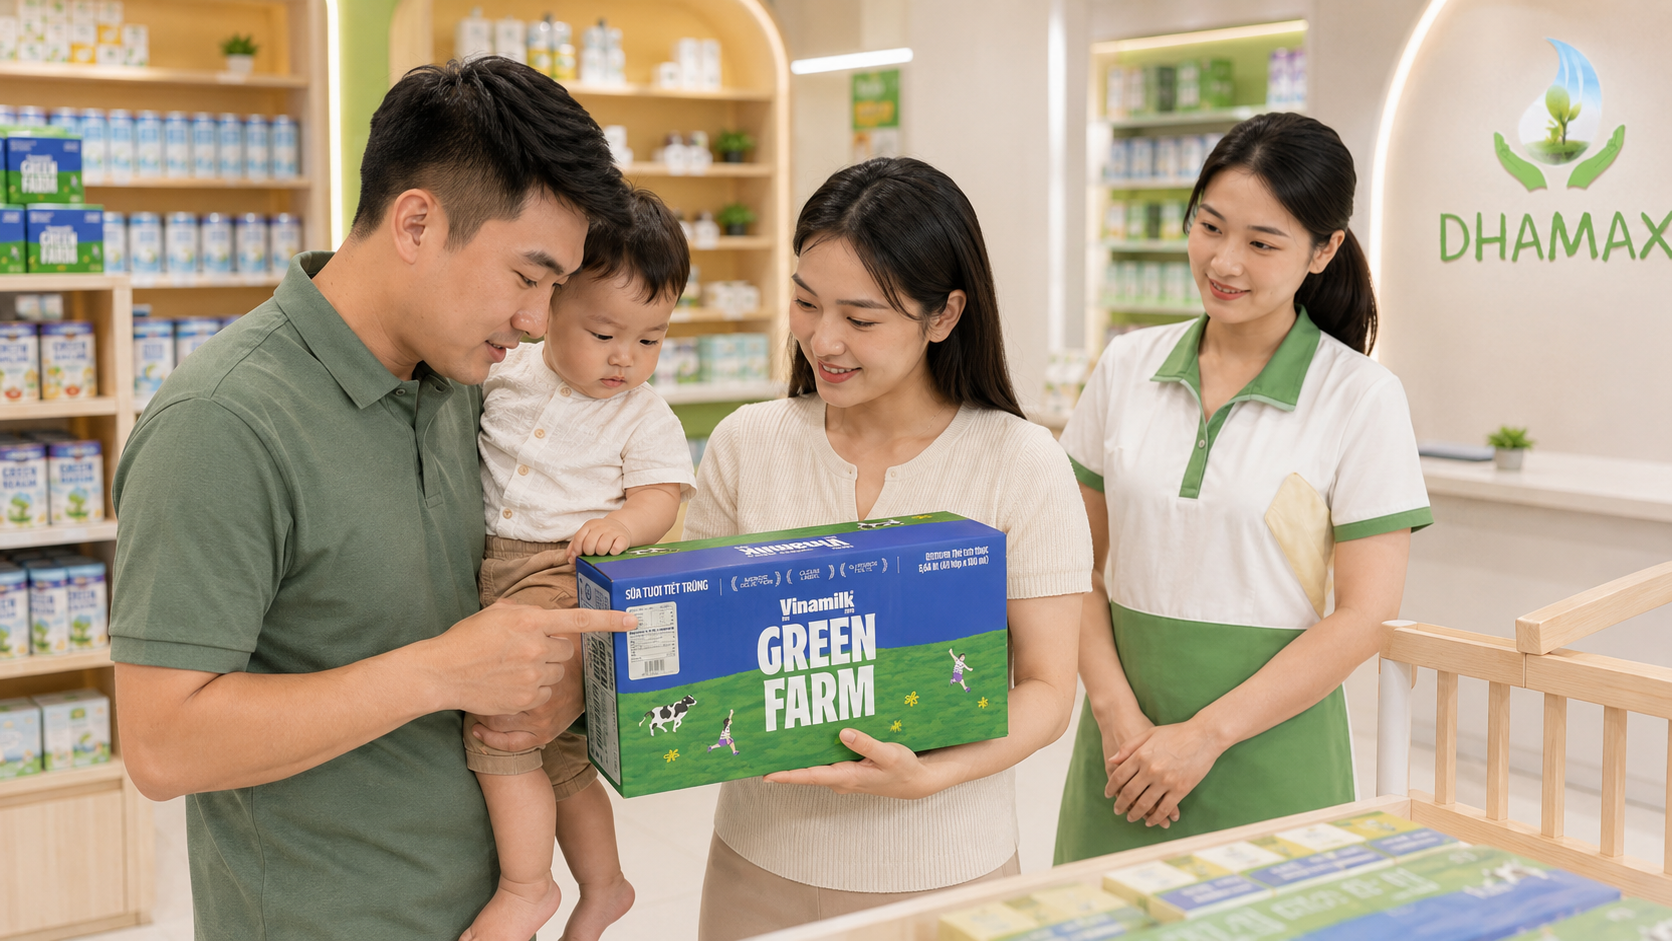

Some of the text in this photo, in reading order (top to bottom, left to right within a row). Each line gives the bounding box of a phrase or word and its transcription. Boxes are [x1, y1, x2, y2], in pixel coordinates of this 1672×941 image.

[1440, 211, 1672, 263] DHAMAX
[780, 592, 855, 616] Vinamilk
[757, 613, 876, 675] GREEN
[763, 664, 875, 732] FARM
